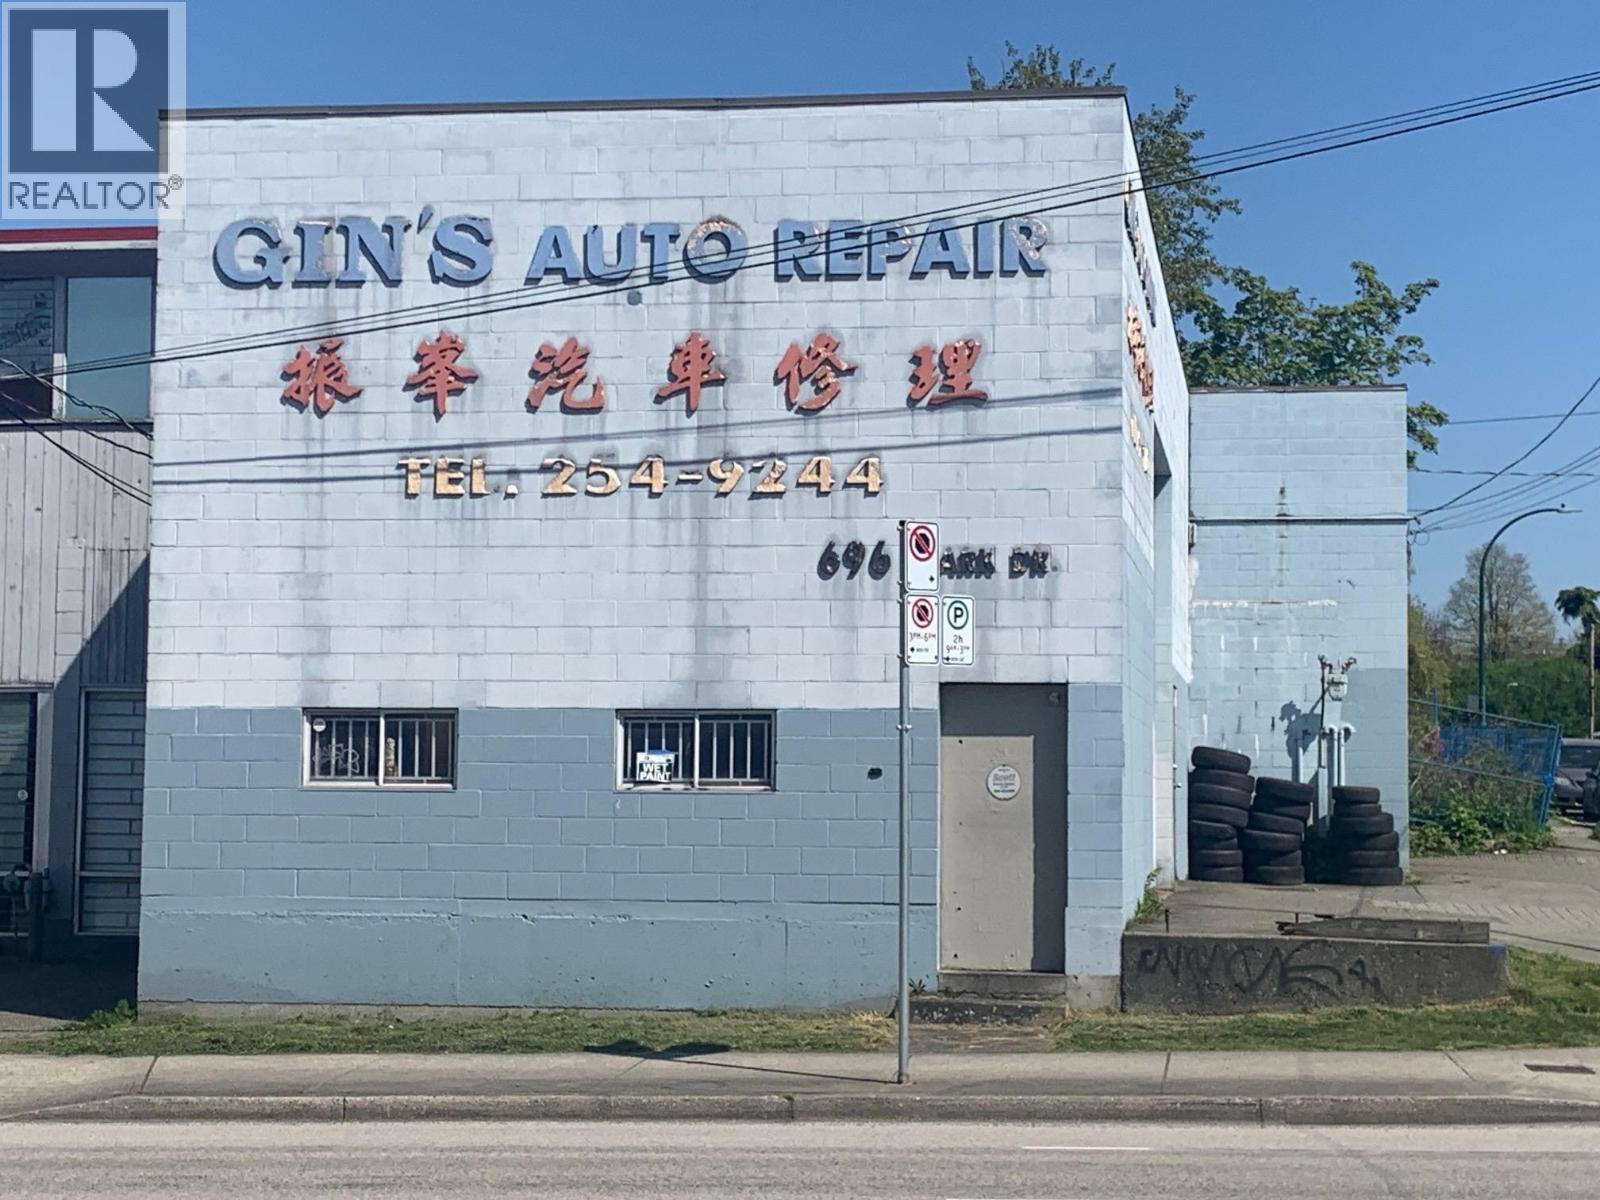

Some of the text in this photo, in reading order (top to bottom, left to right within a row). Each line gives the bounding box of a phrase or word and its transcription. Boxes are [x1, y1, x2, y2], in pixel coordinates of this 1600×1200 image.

[213, 204, 494, 290] GIN'S
[524, 214, 748, 286] AUTO
[773, 214, 1050, 284] REPAIR
[540, 455, 884, 500] 254-9244
[817, 540, 892, 581] 696
[937, 545, 997, 580] ARK
[640, 771, 672, 782] PAINT
[642, 763, 669, 773] WET
